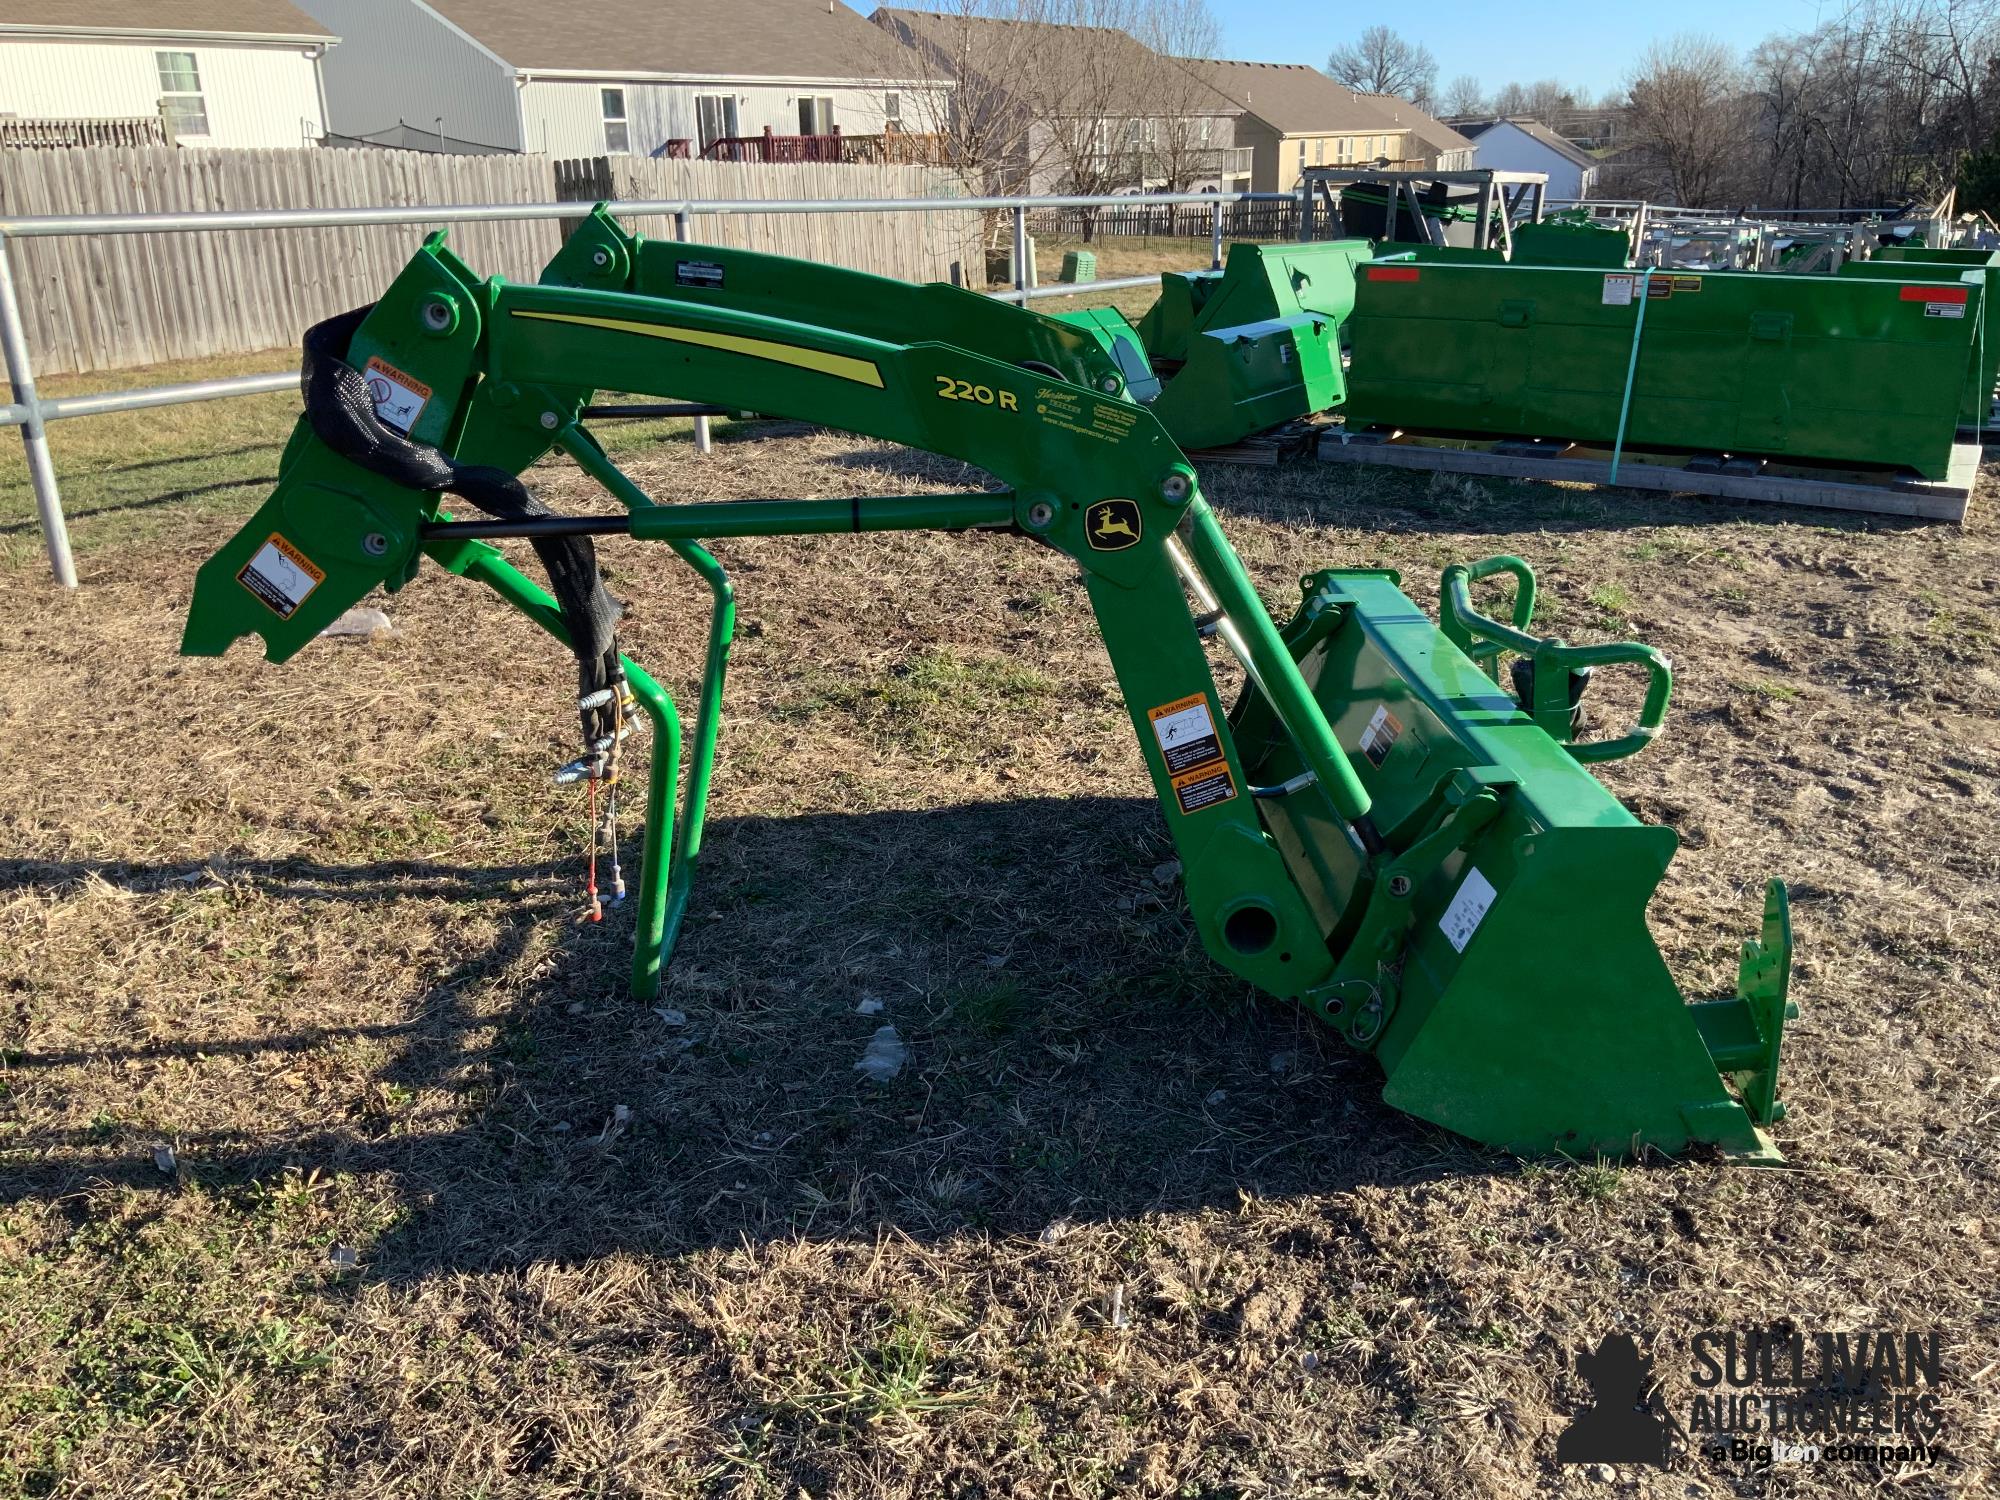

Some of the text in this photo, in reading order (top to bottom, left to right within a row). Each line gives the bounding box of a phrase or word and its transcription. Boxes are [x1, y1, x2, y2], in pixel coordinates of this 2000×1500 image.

[382, 365, 429, 397] WARNING
[281, 542, 321, 580] WARNING
[1163, 697, 1200, 714] WARNING
[1187, 765, 1223, 782] WARNING
